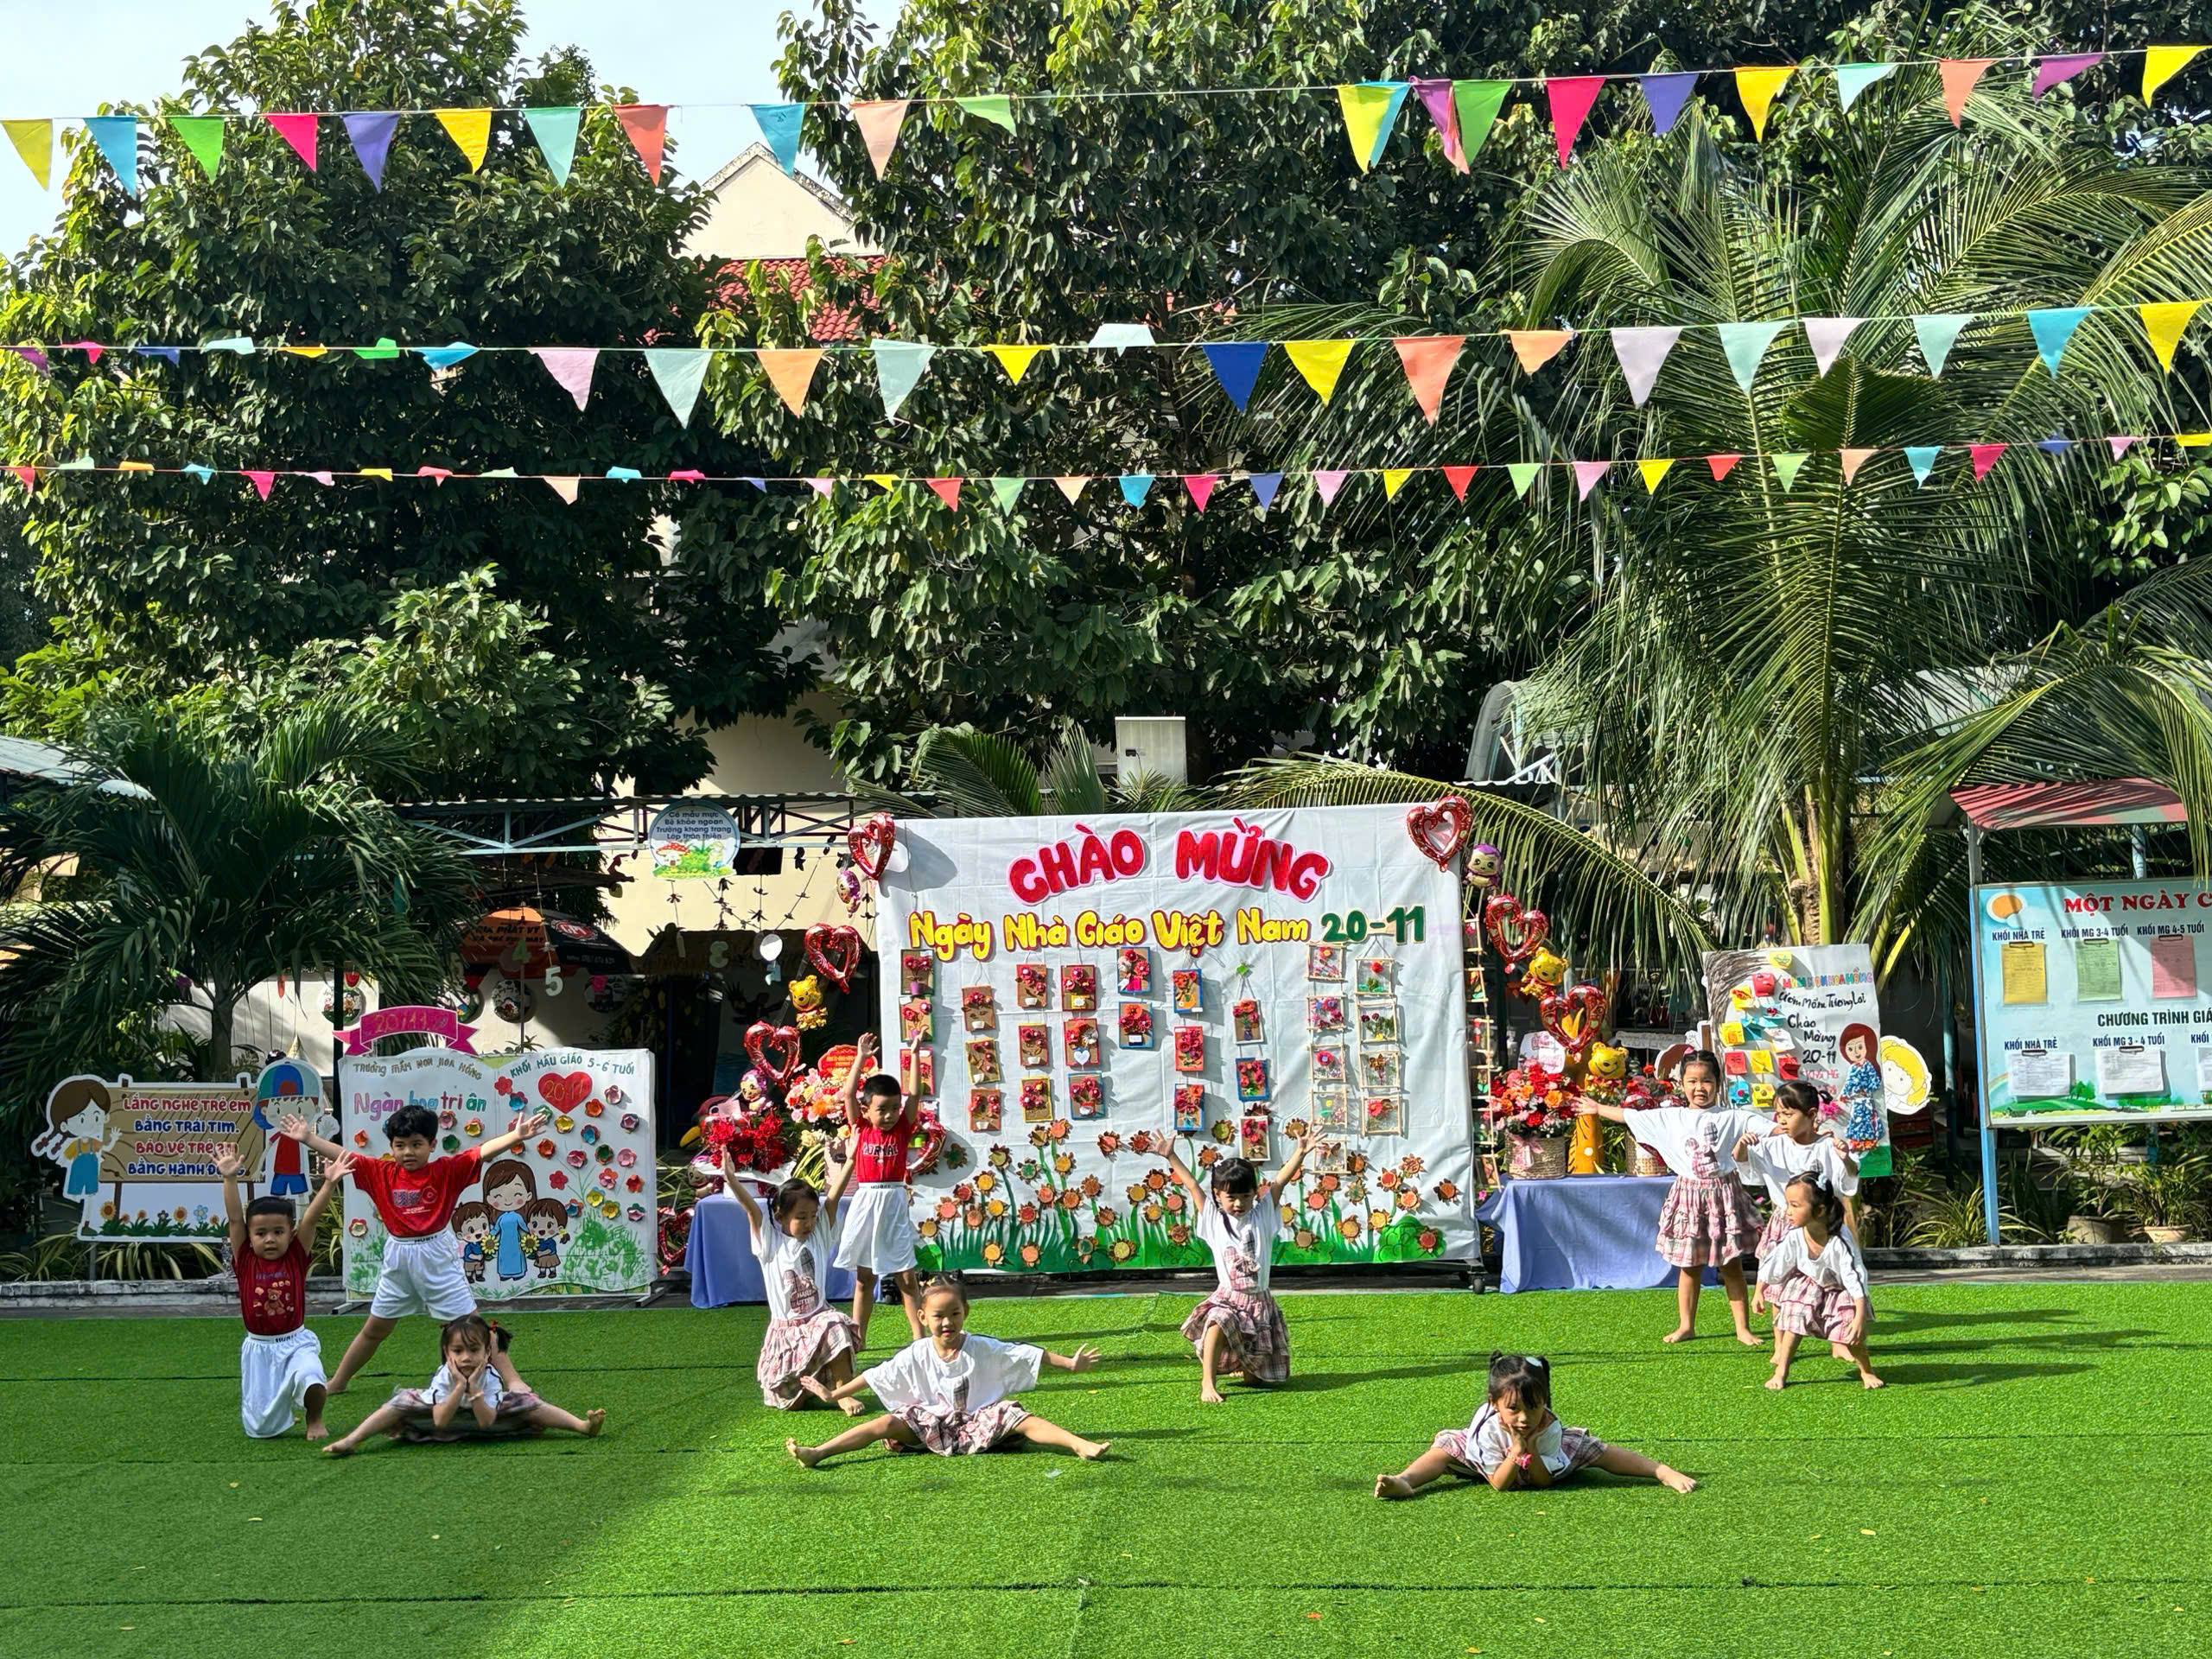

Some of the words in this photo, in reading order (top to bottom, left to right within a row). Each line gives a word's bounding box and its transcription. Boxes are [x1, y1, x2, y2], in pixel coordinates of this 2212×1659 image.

[1007, 823, 1147, 904] CHÀO
[1176, 817, 1332, 902] MỪNG
[2063, 893, 2114, 917] MỘT
[2120, 889, 2190, 911] NGÀY
[909, 911, 993, 963] Ngày
[1004, 912, 1068, 950] Nhà
[1076, 910, 1145, 947] Giáo
[1151, 909, 1225, 957] Việt
[1236, 906, 1311, 944] Nam
[1320, 905, 1426, 944] 20-11
[1992, 929, 2011, 941] KHỐI
[2012, 929, 2029, 940] NHÀ
[2031, 927, 2046, 939] TRẺ
[2061, 925, 2080, 938] KHỐI
[2082, 928, 2094, 938] MG
[2096, 927, 2109, 937] 3-4
[2111, 924, 2129, 937] TUỔI
[2137, 923, 2156, 936] KHỐI
[2158, 925, 2170, 935] MG
[2172, 925, 2185, 935] 4-5
[2187, 920, 2205, 933] TUỔI
[545, 966, 563, 996] 5
[1788, 1013, 1816, 1028] Chào
[2097, 1012, 2149, 1027] CHƯƠNG
[2152, 1009, 2190, 1025] TRÌNH
[2004, 1037, 2023, 1050] KHỐI
[2024, 1038, 2040, 1049] NHÀ
[2043, 1036, 2058, 1049] TRẺ
[2093, 1034, 2111, 1046] KHỐI
[2113, 1037, 2126, 1046] MG
[2147, 1032, 2165, 1045] TUỔI
[2190, 1030, 2209, 1044] KHỐI
[560, 1052, 582, 1065] GIÁO
[1802, 1050, 1837, 1065] 20-11
[353, 1091, 404, 1122] Ngàn
[441, 1090, 463, 1110] tri
[466, 1092, 486, 1112] ân
